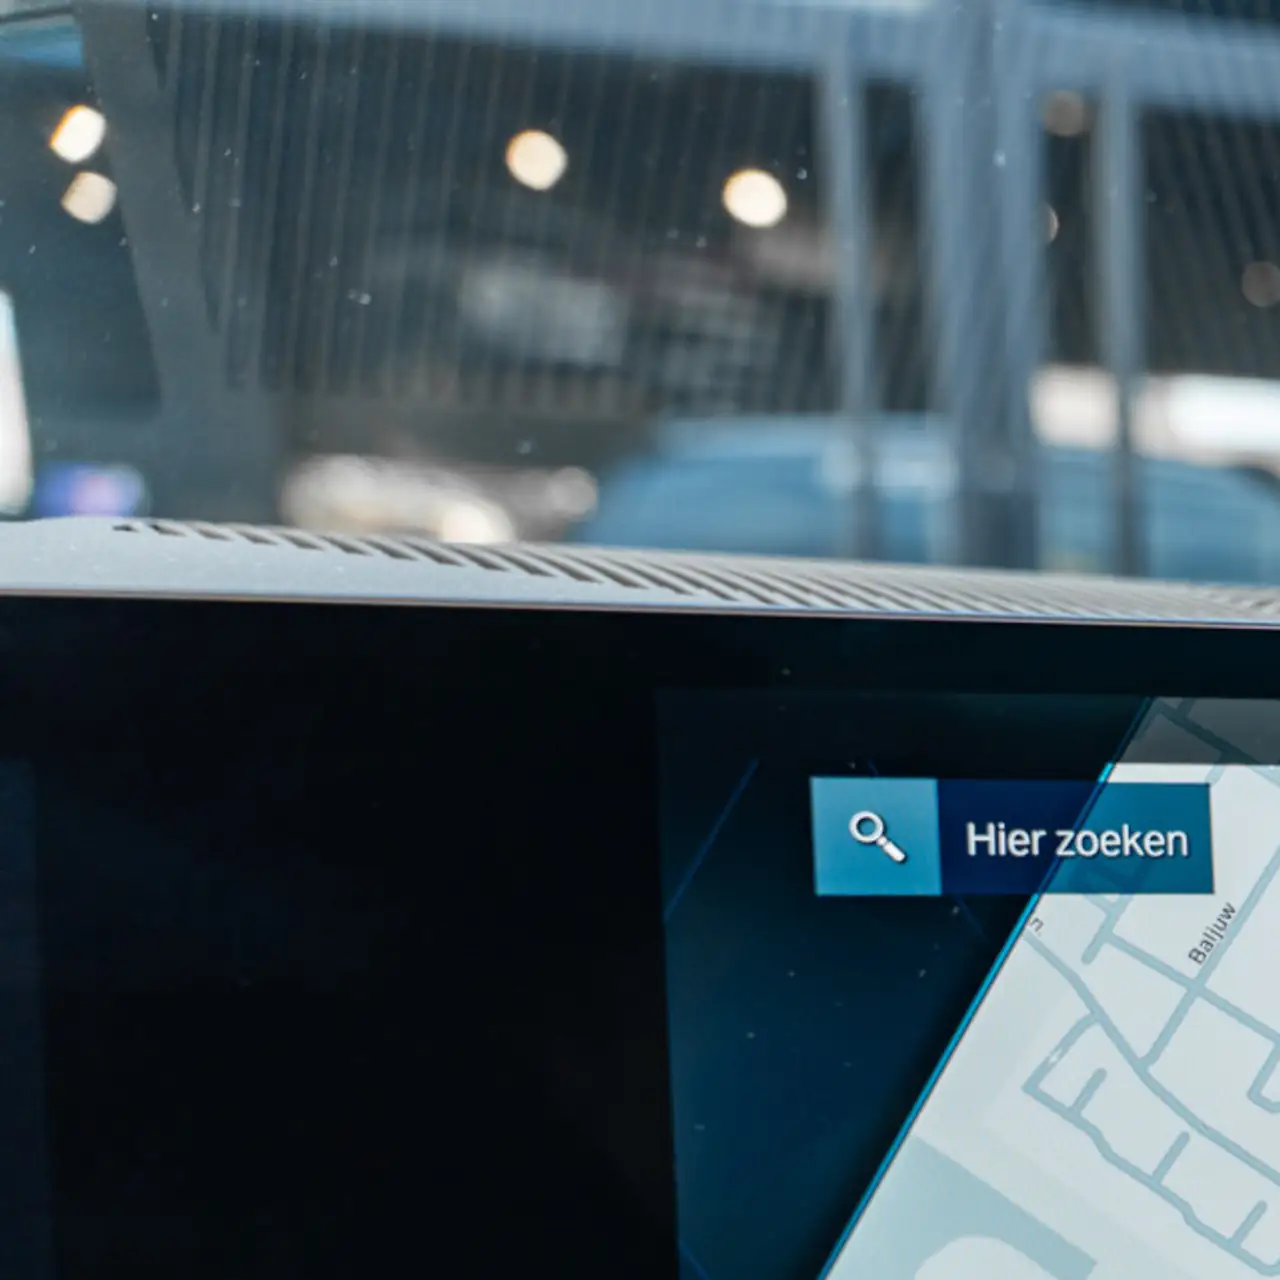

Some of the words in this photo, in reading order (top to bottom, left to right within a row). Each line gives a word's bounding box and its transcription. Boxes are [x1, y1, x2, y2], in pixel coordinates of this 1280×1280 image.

[966, 822, 1046, 858] Hier
[1055, 822, 1190, 859] zoeken
[1187, 901, 1238, 965] Baljuw
